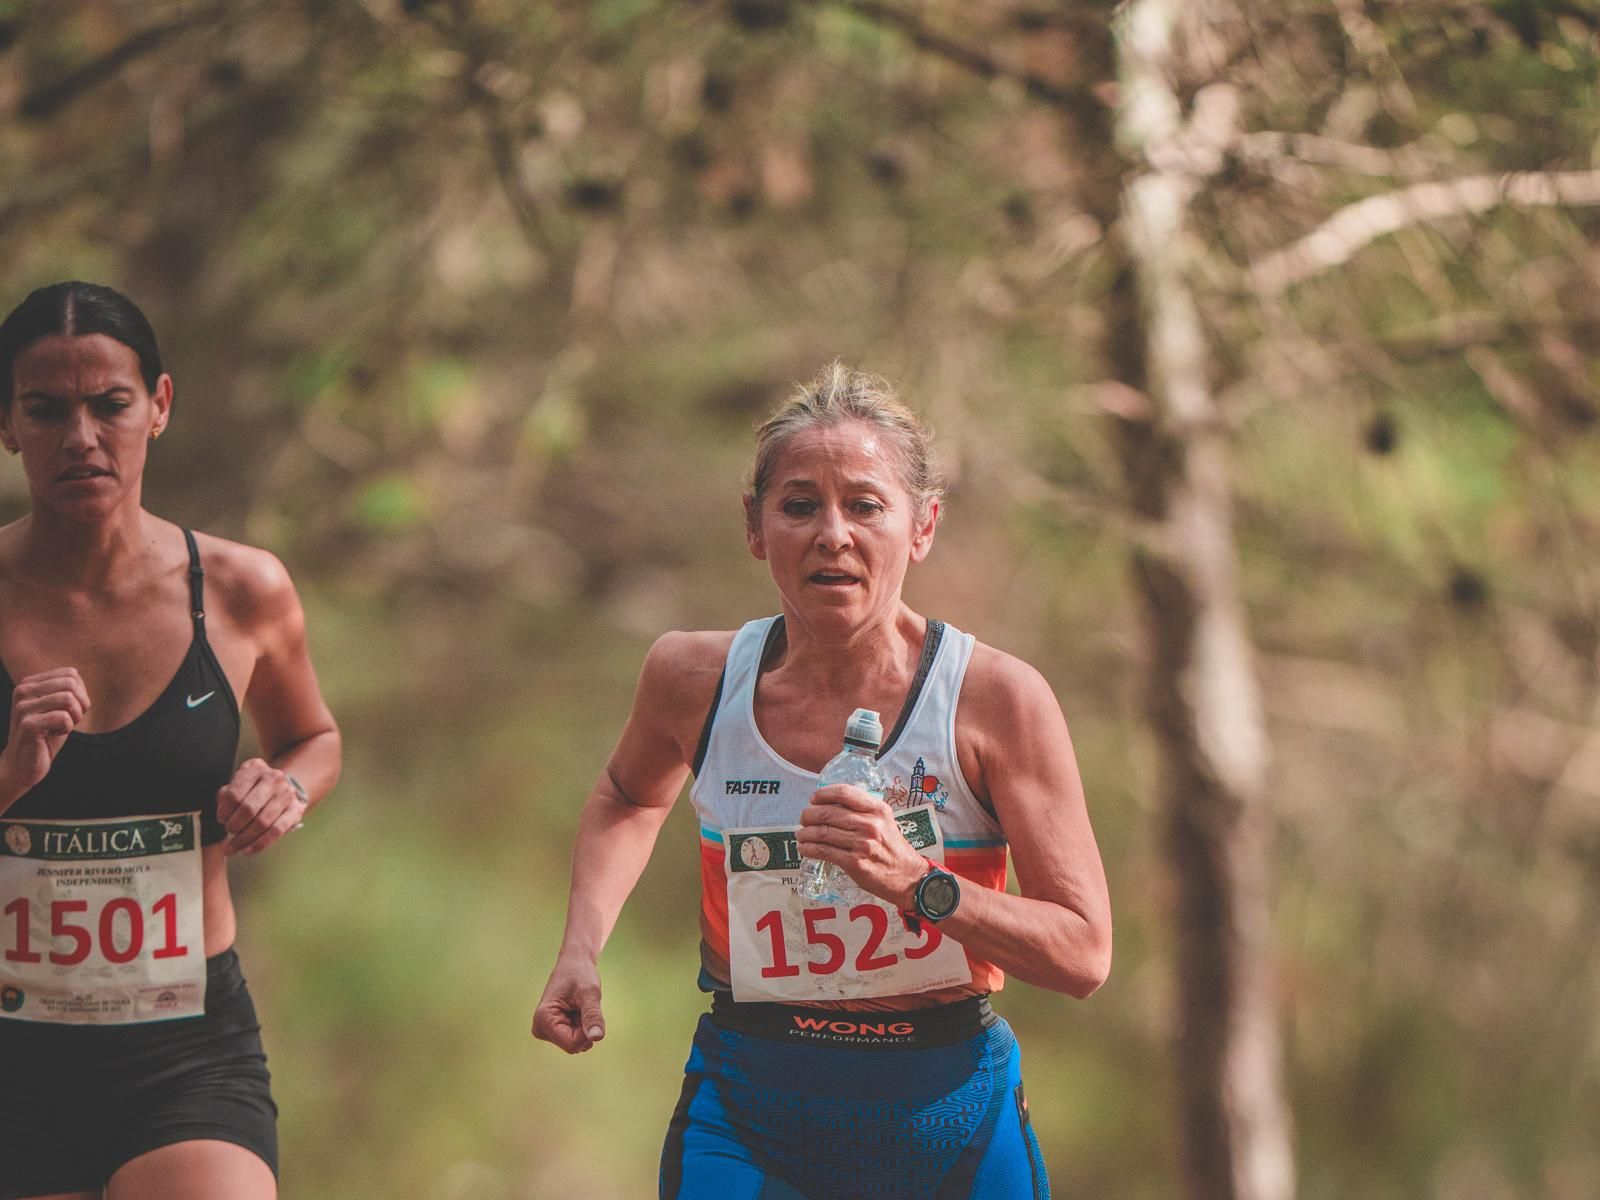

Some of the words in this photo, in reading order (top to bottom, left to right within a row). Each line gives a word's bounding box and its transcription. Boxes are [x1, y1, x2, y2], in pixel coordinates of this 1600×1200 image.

[725, 780, 780, 794] FASTER
[44, 827, 145, 853] ITÁLICA
[37, 867, 82, 877] JENNIFER
[84, 866, 122, 875] RIVERO
[56, 877, 133, 886] INDEPENDIENTE
[4, 893, 188, 966] 1501
[793, 1015, 914, 1035] WONG
[788, 1029, 915, 1043] PERFORMANCE
